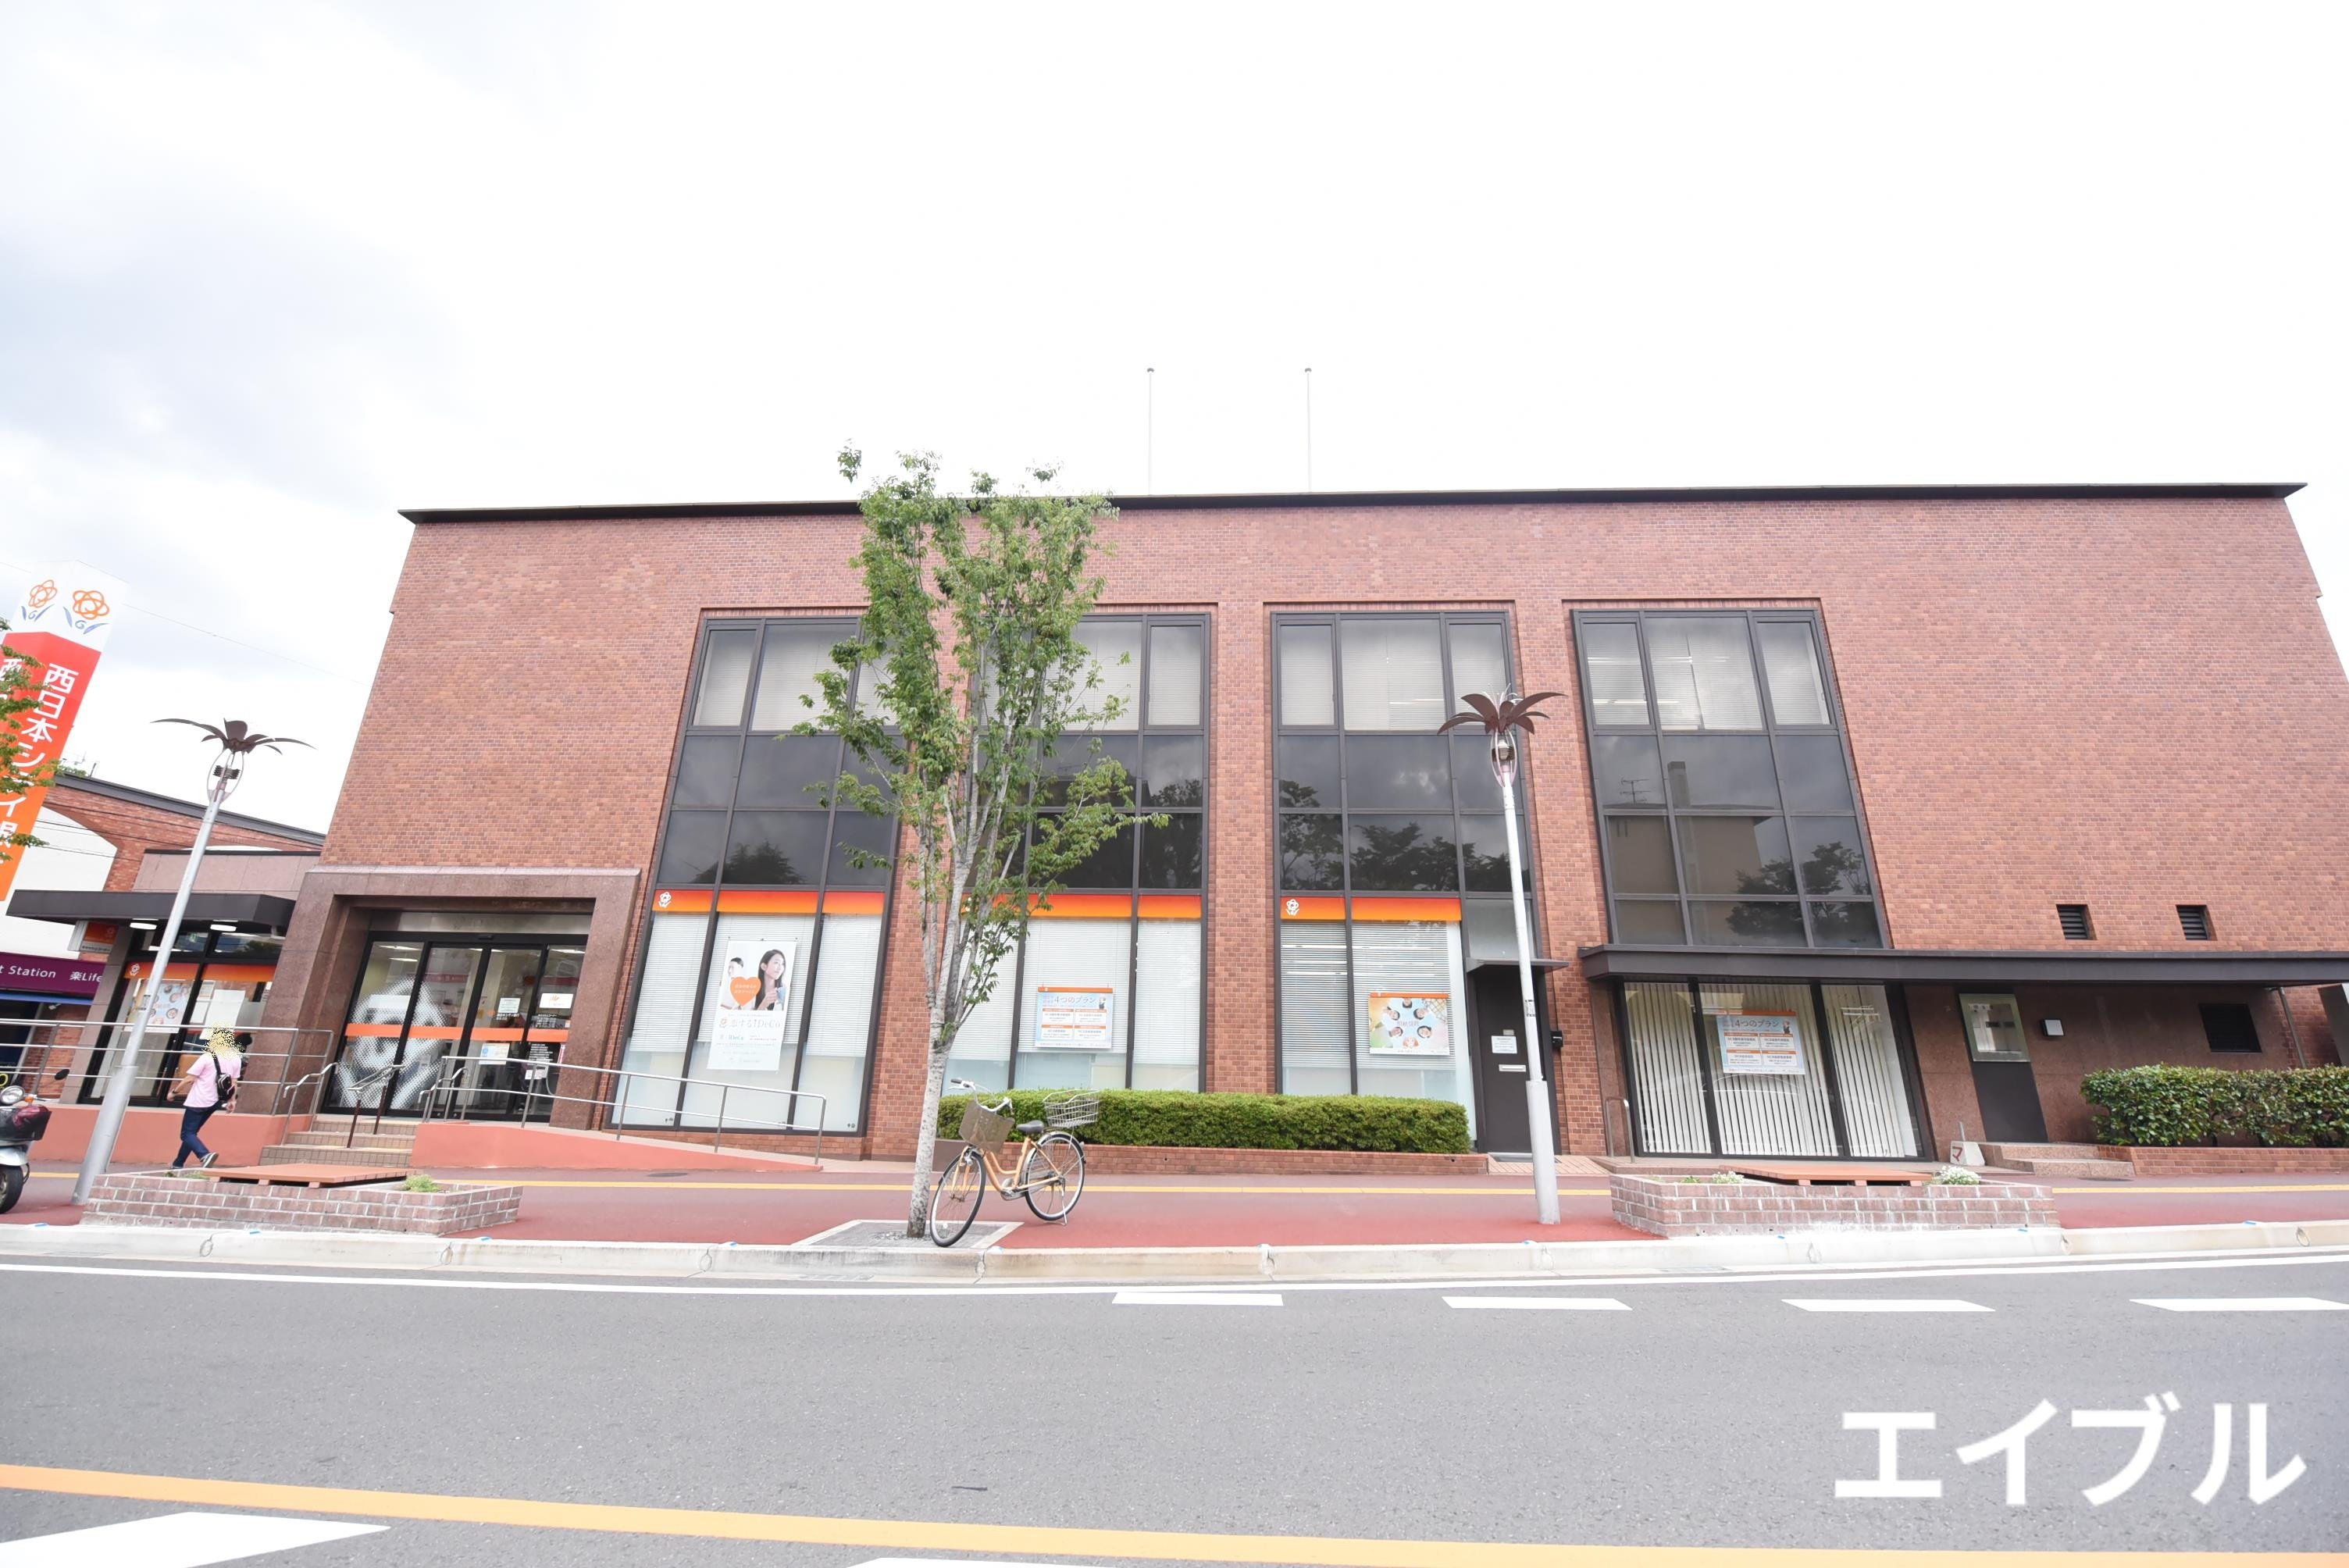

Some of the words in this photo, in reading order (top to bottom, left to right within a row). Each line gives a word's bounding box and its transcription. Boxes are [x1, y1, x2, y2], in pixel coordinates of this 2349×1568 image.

[0, 663, 79, 864] 西日本シィ
[8, 965, 56, 978] Station
